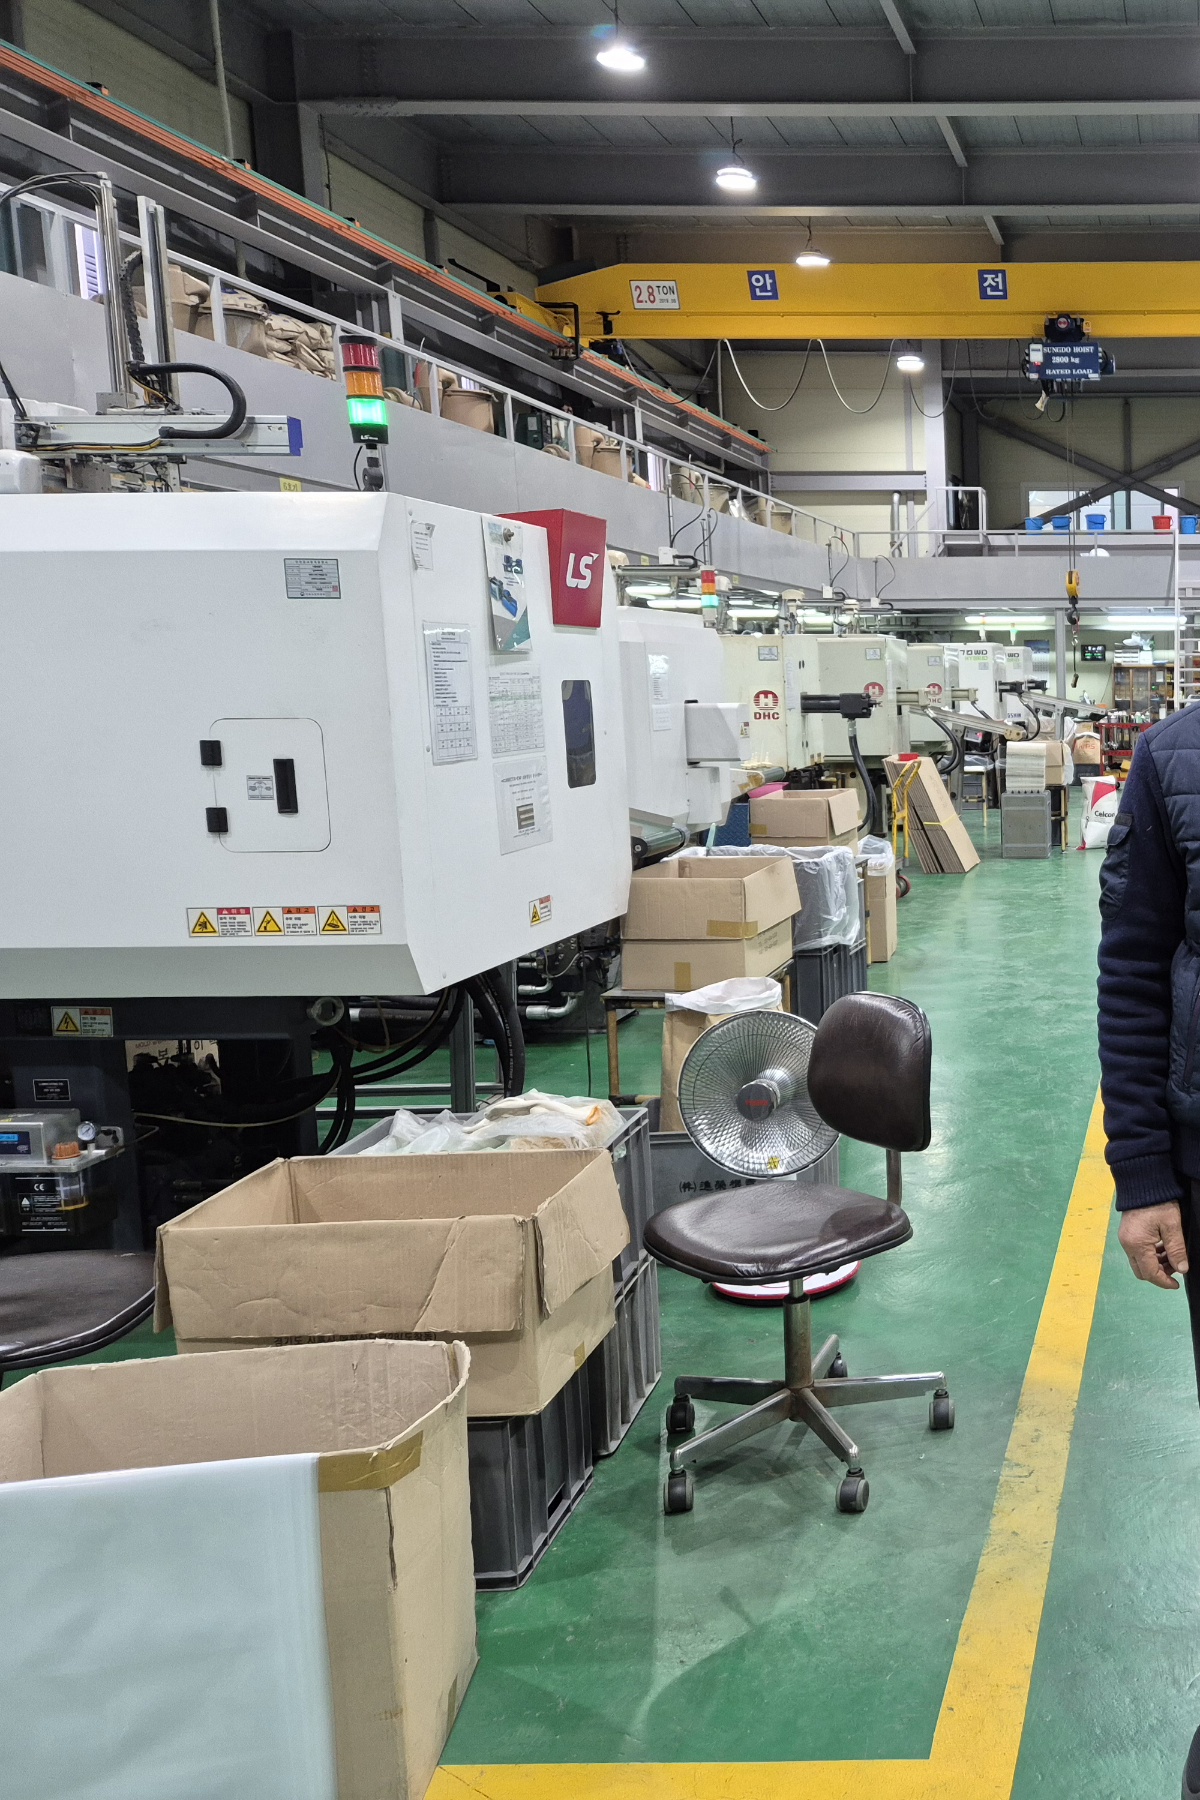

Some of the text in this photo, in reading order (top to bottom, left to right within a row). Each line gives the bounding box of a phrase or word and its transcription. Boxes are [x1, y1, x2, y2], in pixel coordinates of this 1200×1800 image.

[751, 273, 773, 296] 안
[983, 272, 1004, 296] 전
[634, 284, 675, 304] 2.8 TON
[1043, 346, 1071, 354] SUNGDO
[1052, 355, 1080, 364] 2800 kg
[566, 552, 597, 590] LS
[753, 711, 780, 720] DHC
